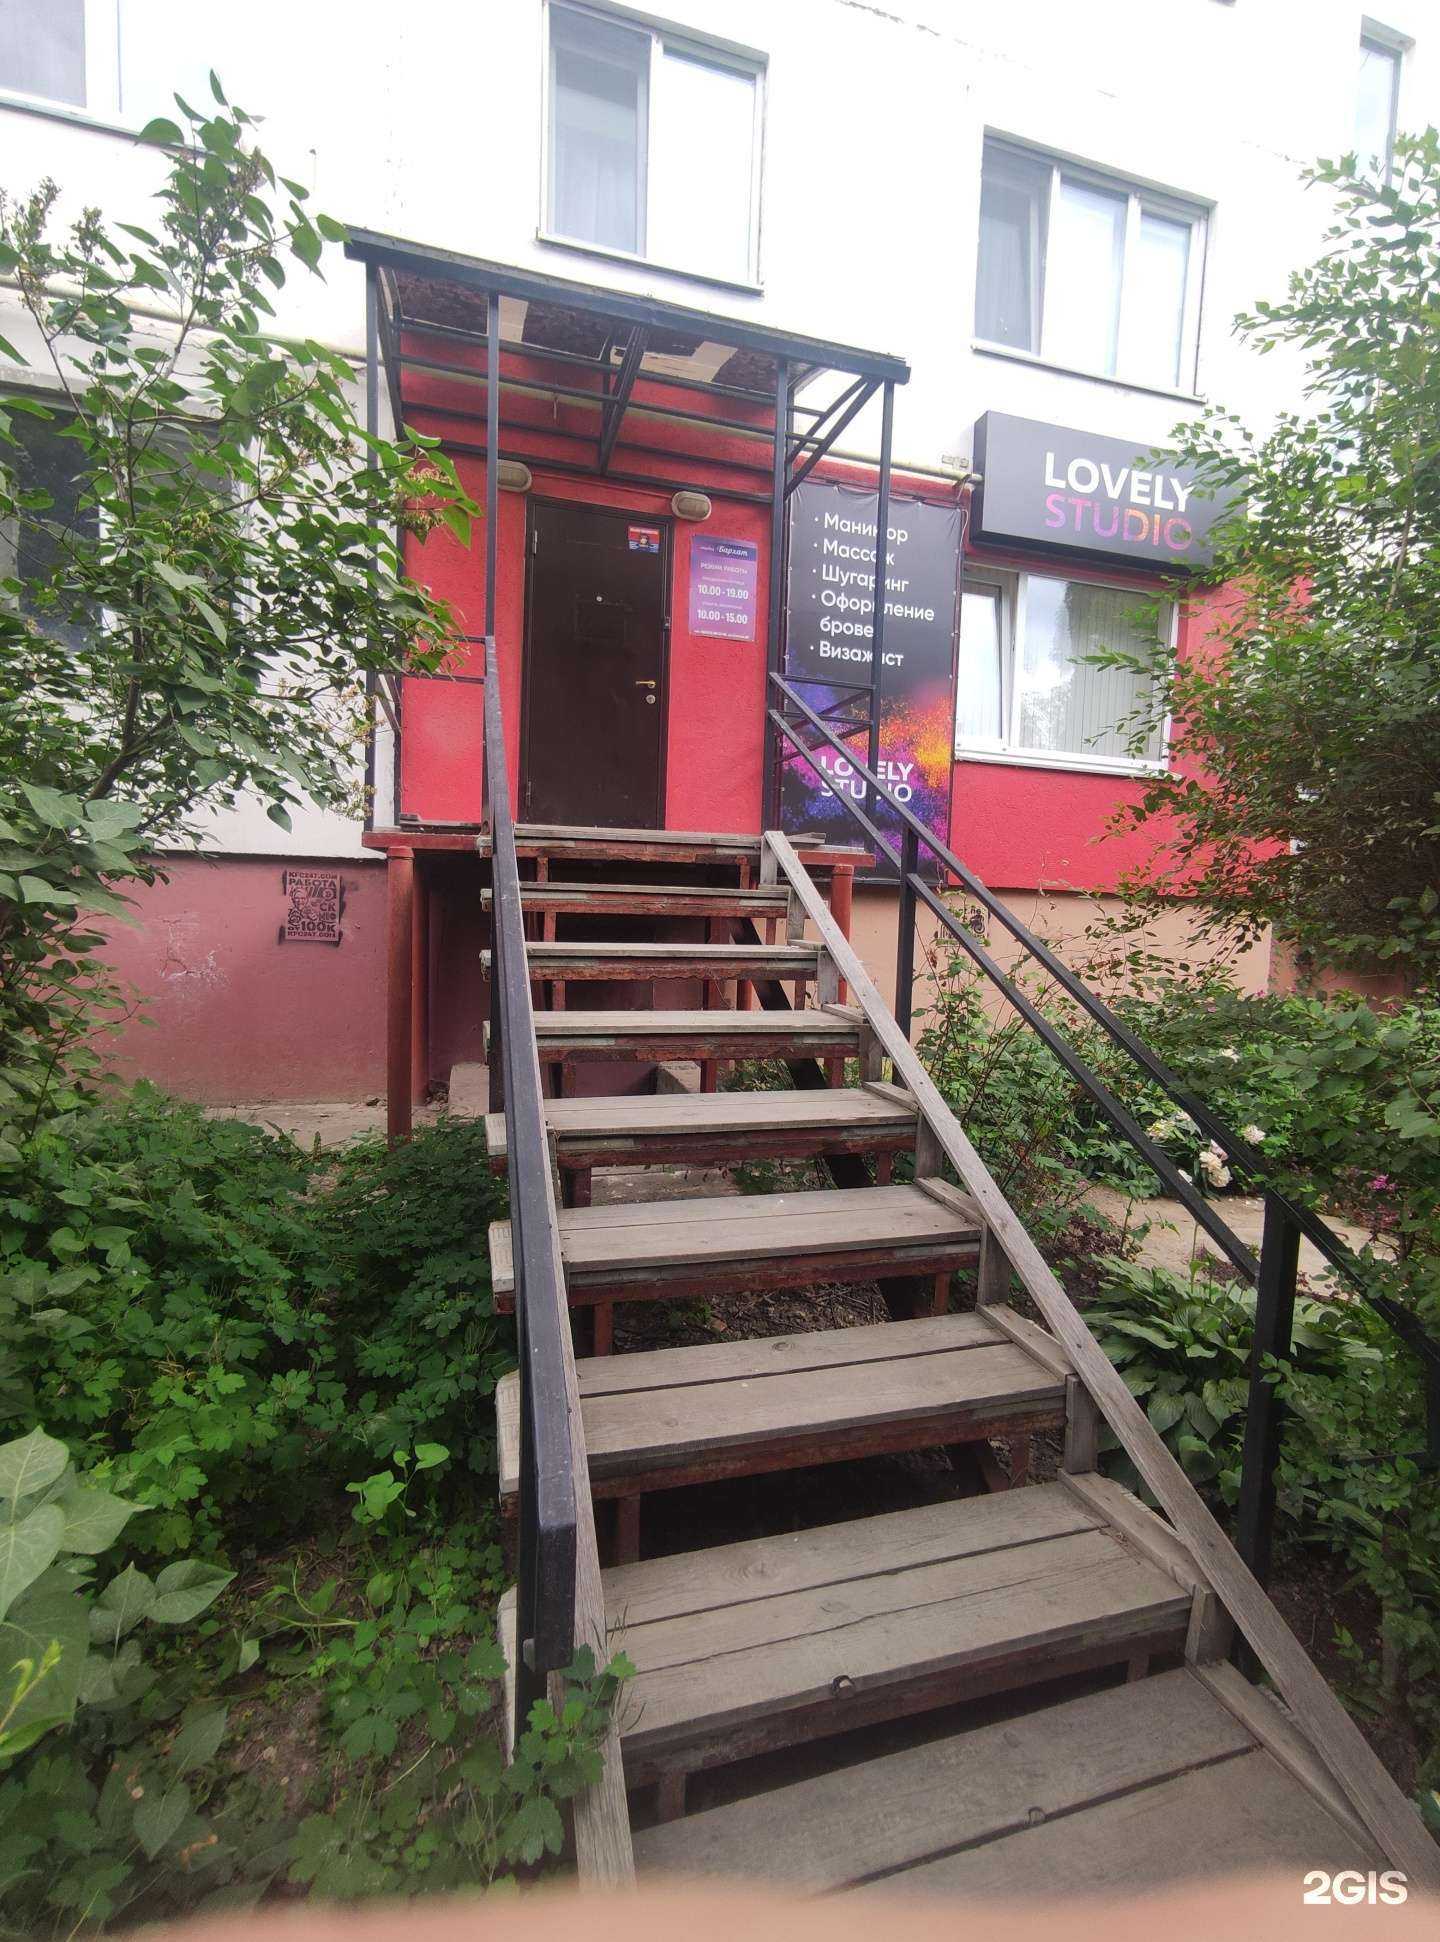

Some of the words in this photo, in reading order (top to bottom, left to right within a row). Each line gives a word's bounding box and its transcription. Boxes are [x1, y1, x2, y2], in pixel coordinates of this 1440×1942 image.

[1044, 452, 1195, 512] LOVELY
[1044, 493, 1193, 551] STUDIO
[697, 584, 720, 596] 10.00
[697, 609, 720, 621] 10.00
[725, 612, 748, 625] 15.00
[821, 590, 935, 621] Офорление
[820, 616, 874, 638] брове
[819, 640, 905, 666] Визажст
[820, 756, 914, 781] LOELY
[820, 779, 912, 803] STUIO
[289, 879, 336, 887] РАБОТА
